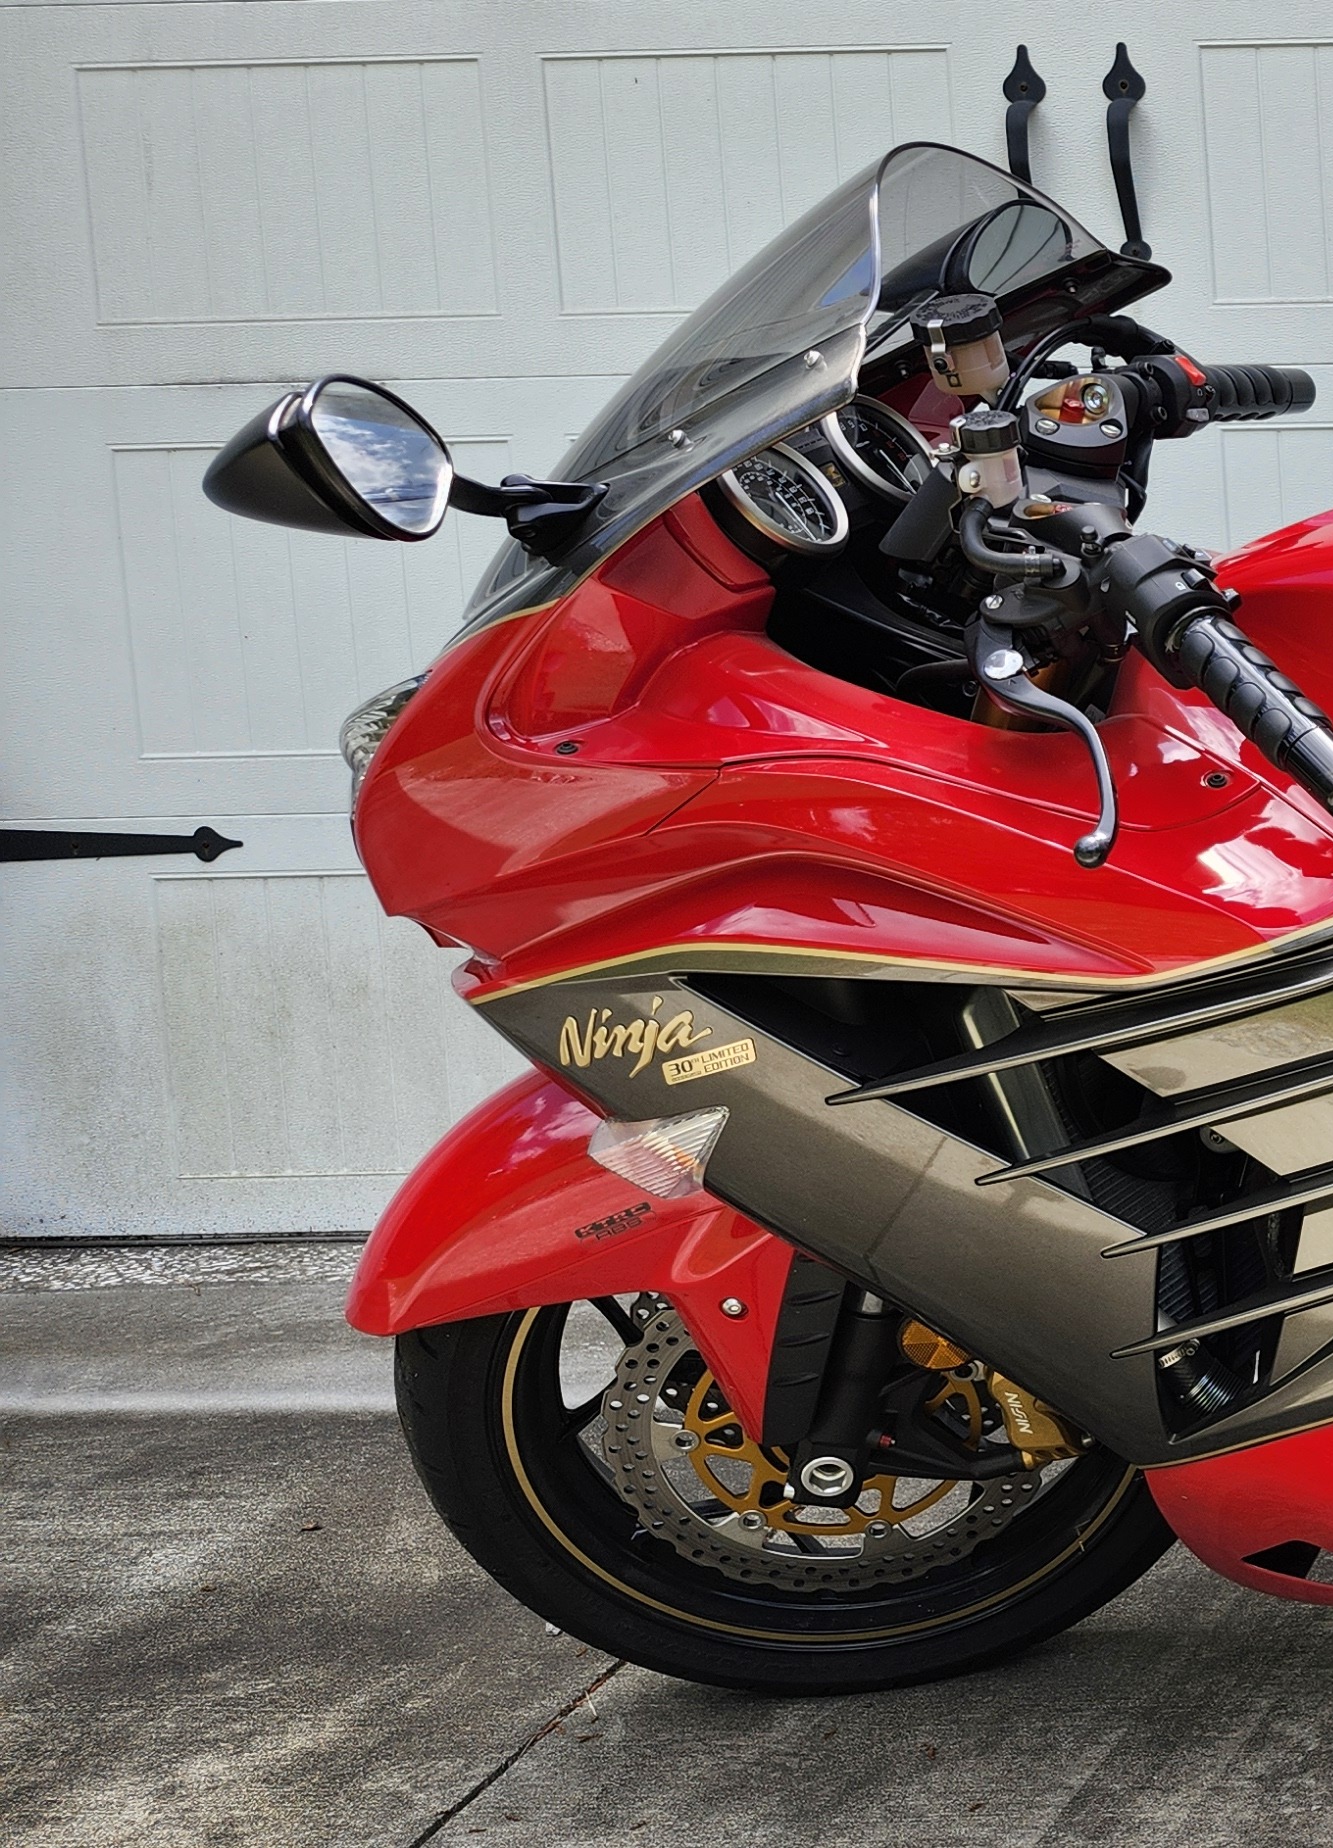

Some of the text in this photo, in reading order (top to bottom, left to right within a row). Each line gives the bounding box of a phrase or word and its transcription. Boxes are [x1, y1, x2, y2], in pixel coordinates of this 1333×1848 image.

[559, 995, 713, 1078] Ninja
[701, 1042, 749, 1064] LIMITED
[704, 1053, 750, 1073] EDITION
